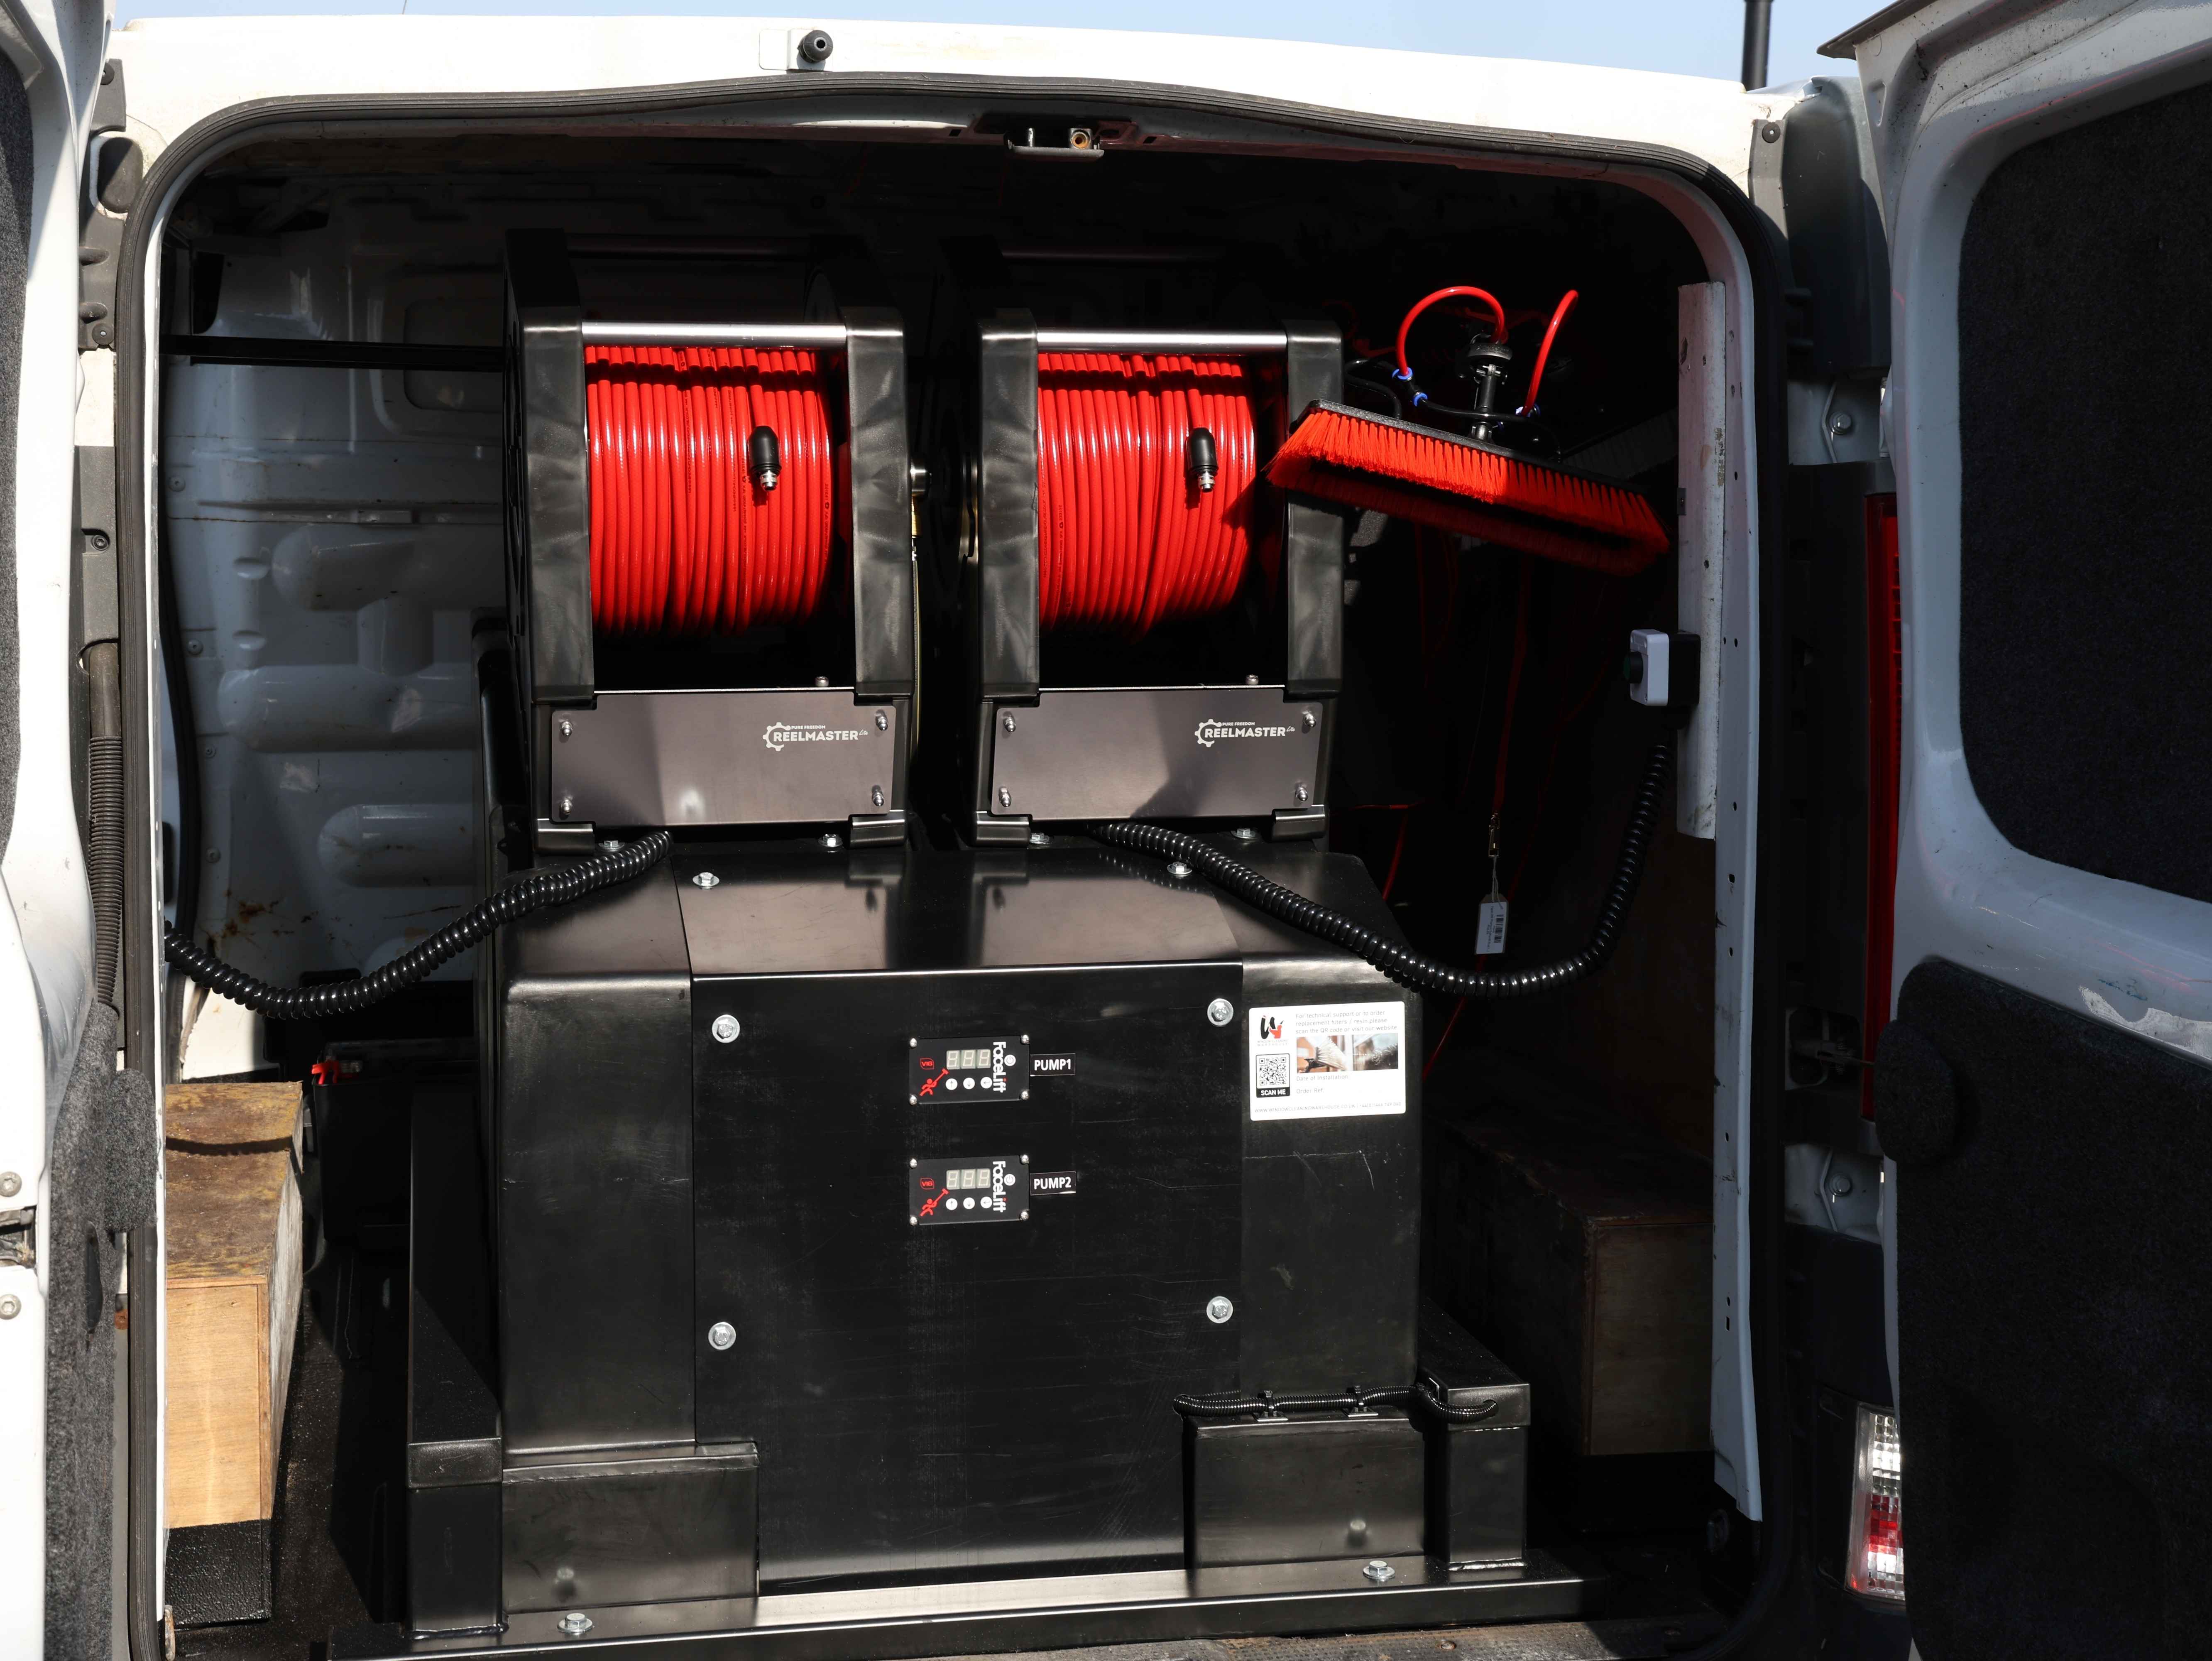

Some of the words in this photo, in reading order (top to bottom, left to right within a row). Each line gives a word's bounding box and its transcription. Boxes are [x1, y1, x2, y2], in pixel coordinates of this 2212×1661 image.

[773, 730, 859, 742] REELMASTER
[1204, 727, 1286, 738] REELMASTER
[1034, 1059, 1071, 1071] PUMP1
[1033, 1176, 1072, 1189] PUMP2
